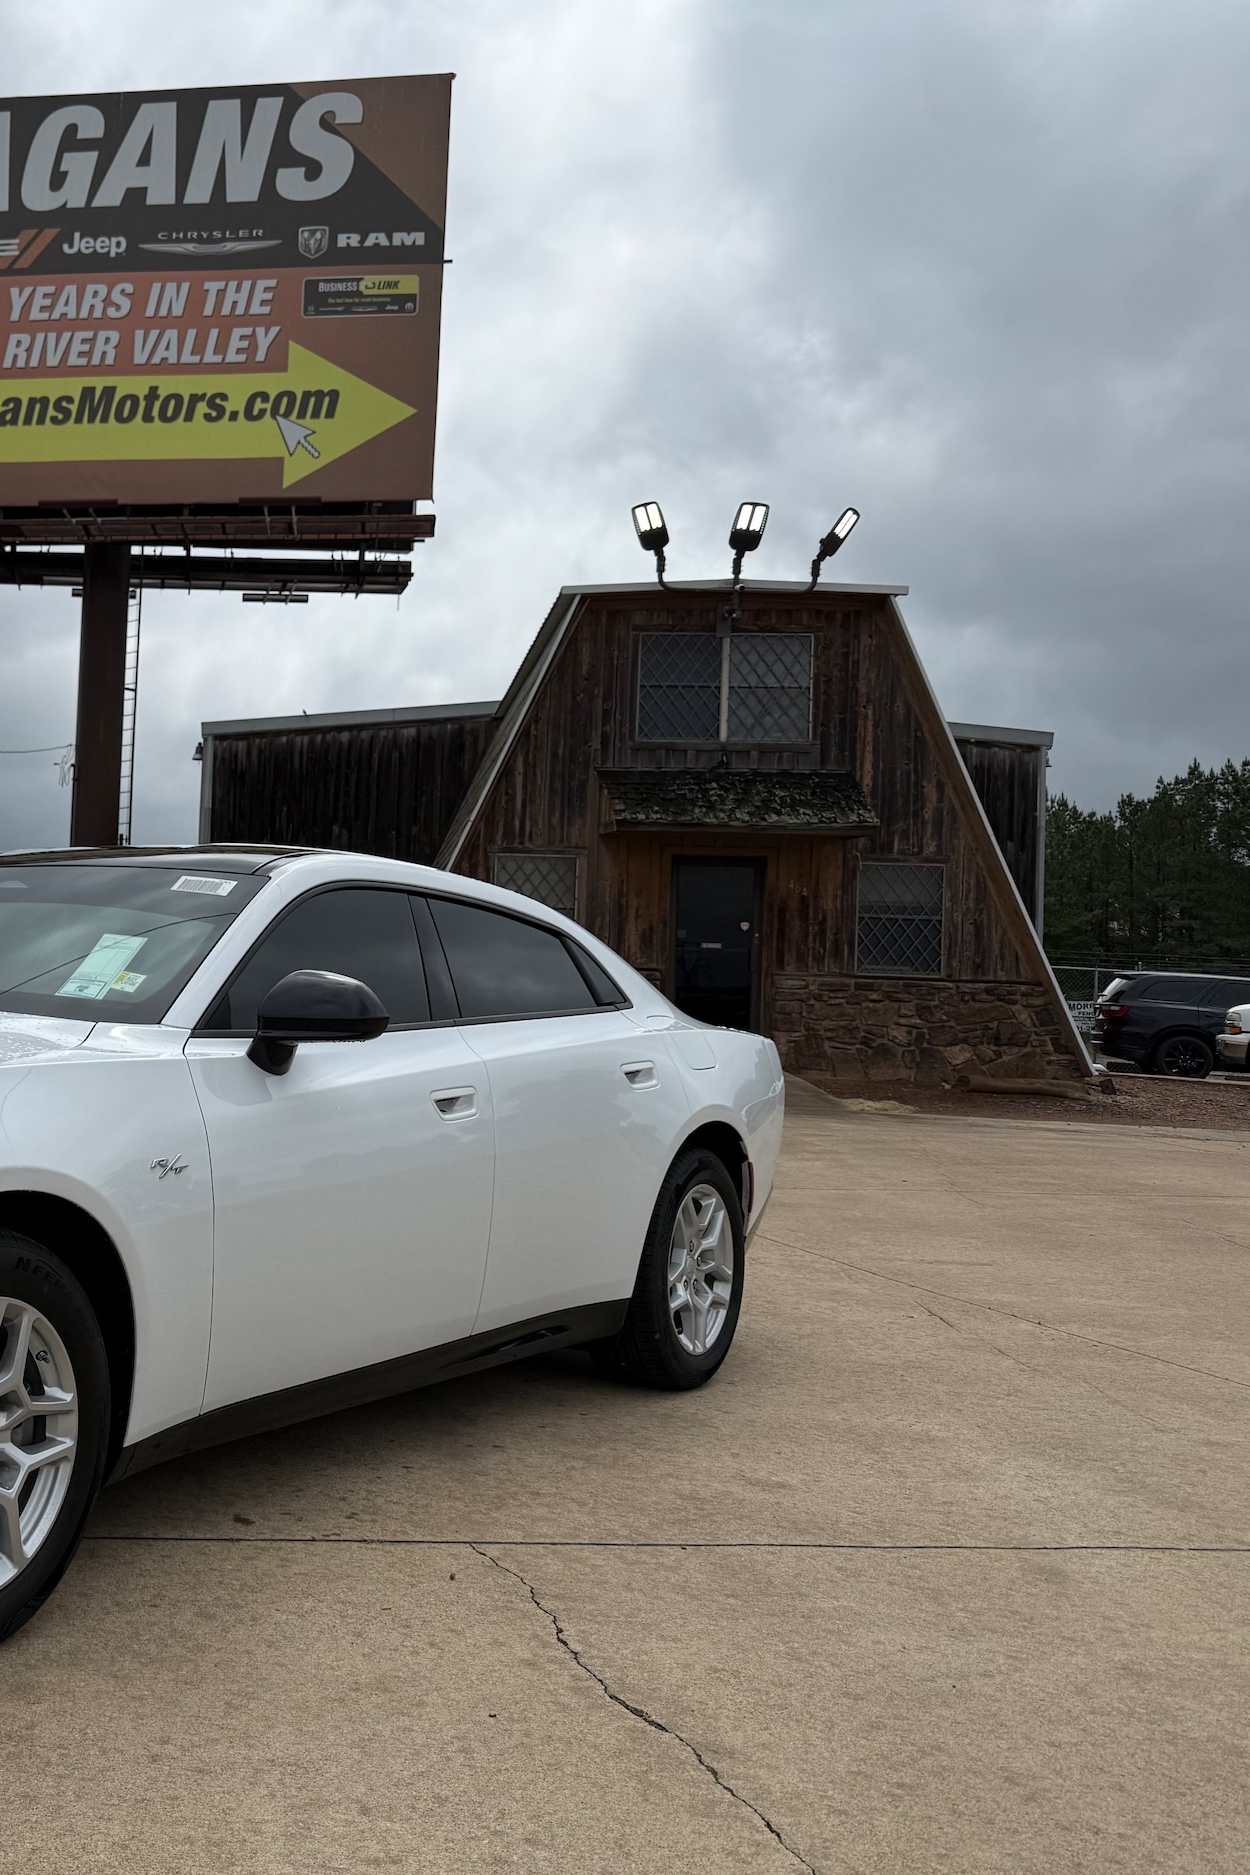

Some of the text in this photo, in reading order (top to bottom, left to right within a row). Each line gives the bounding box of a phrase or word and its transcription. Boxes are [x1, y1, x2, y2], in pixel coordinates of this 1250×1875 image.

[157, 228, 264, 240] CHRYSLER
[336, 231, 426, 248] RAM
[62, 232, 127, 258] Jeep
[318, 280, 400, 293] BUSINESS LINK
[9, 279, 278, 323] YEARS IN THE
[2, 326, 282, 370] RIVER VALLEY
